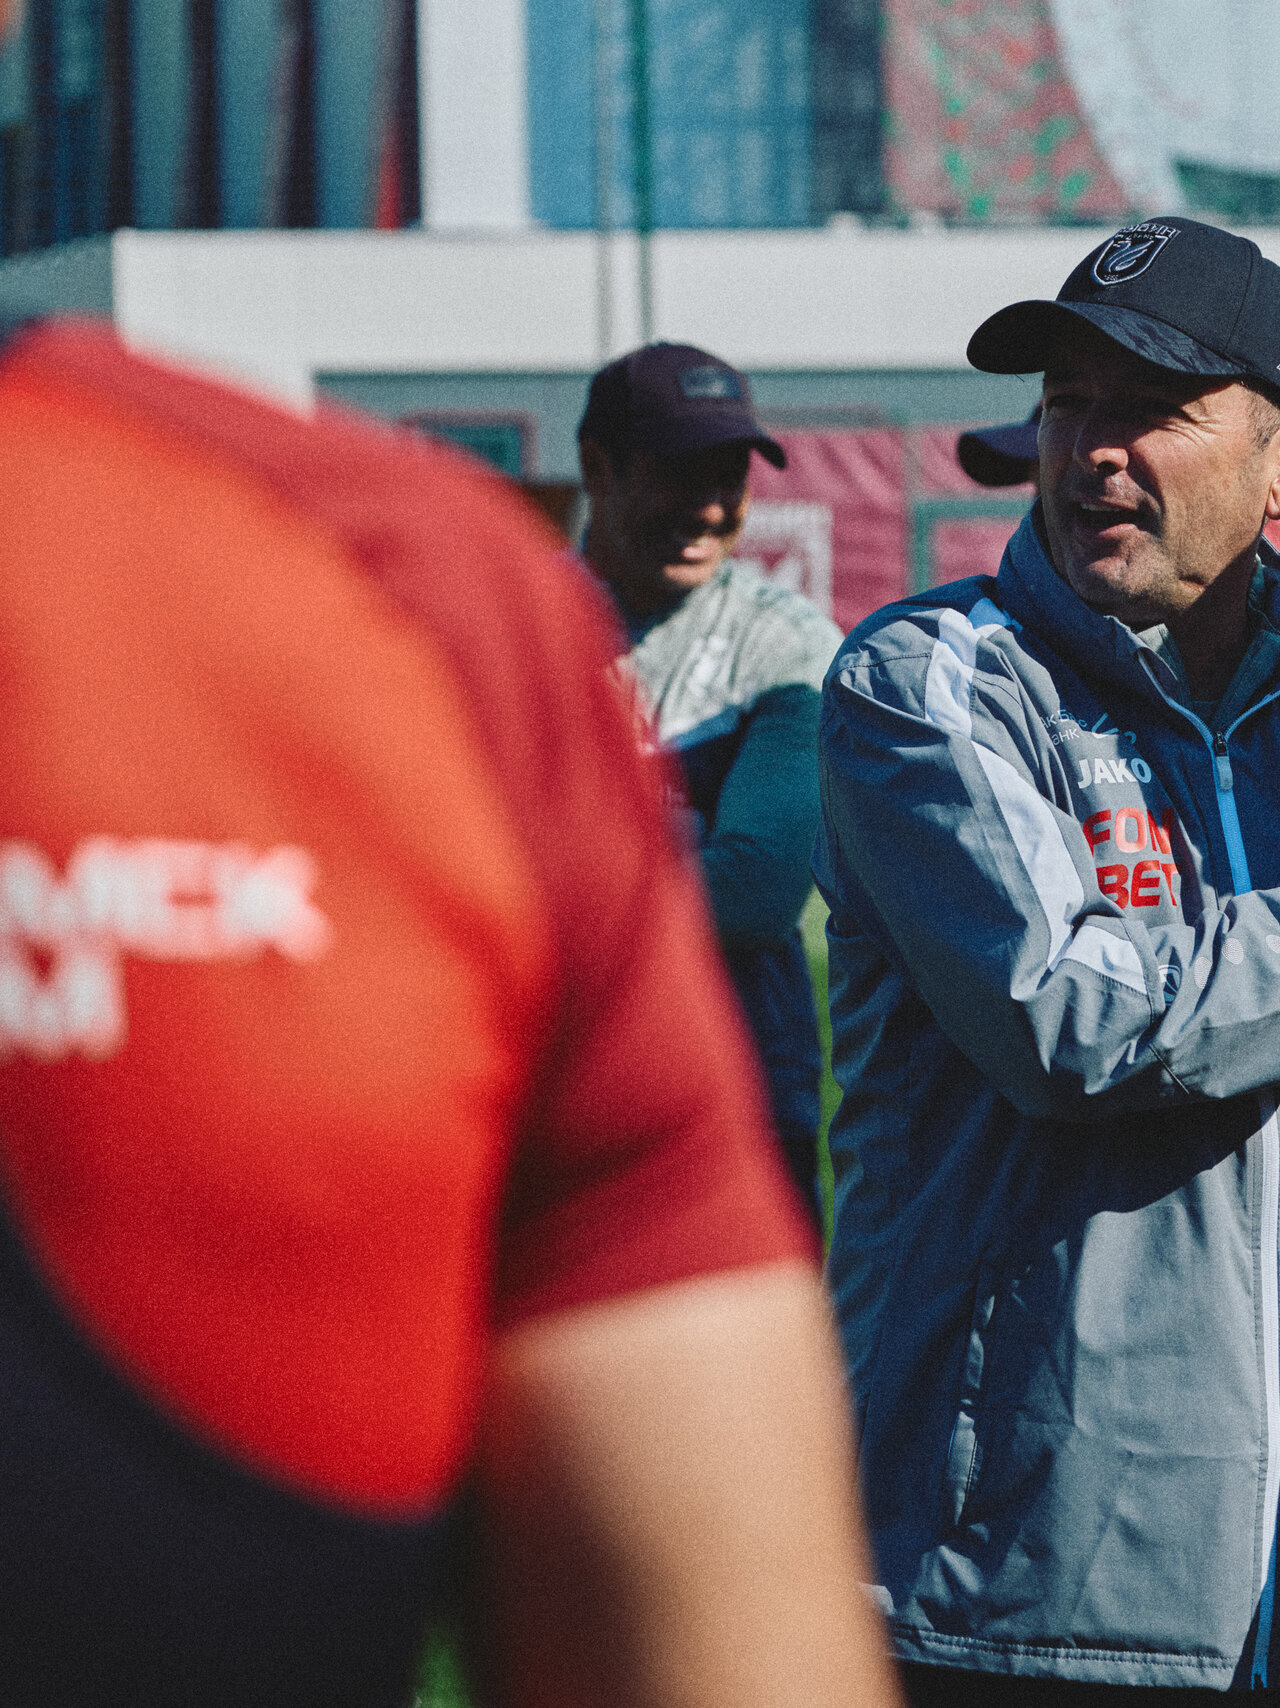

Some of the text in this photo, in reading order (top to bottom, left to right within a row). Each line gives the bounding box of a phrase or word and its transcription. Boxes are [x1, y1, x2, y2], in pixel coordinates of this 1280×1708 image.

[1051, 729, 1079, 746] анк
[1078, 758, 1152, 789] JAKO
[1082, 807, 1175, 857] FON
[1096, 860, 1182, 909] BET
